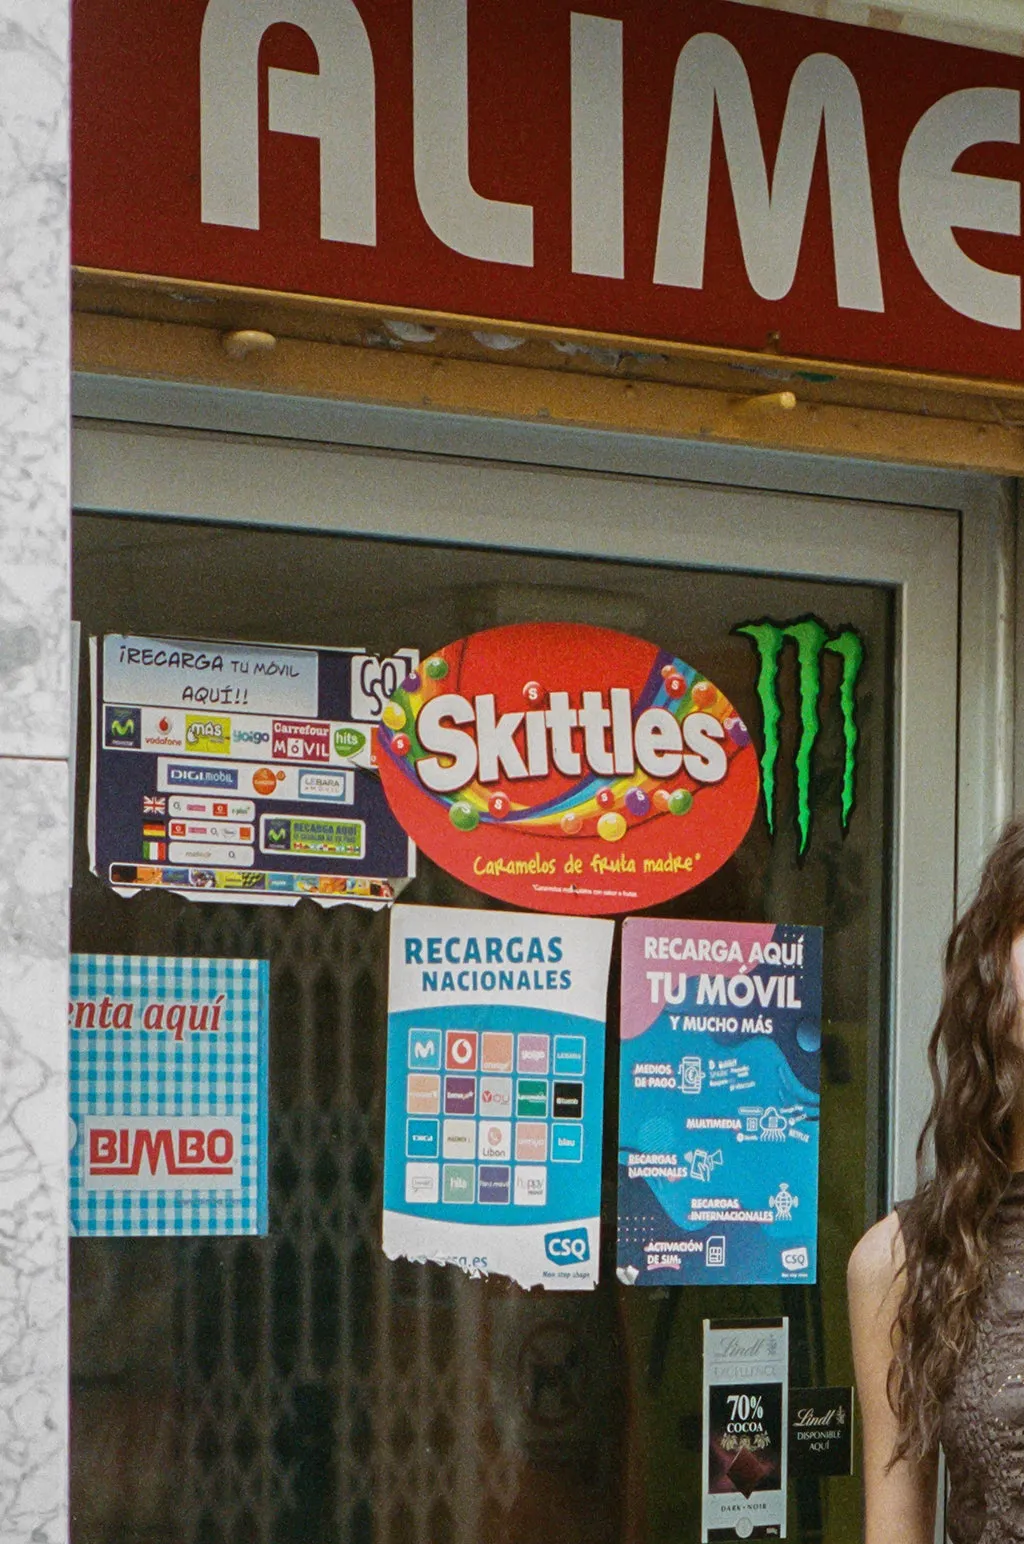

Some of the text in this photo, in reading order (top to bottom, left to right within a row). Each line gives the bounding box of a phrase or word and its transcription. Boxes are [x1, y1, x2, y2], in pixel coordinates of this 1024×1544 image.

[231, 660, 249, 674] TU
[254, 660, 300, 677] MÓVIL
[182, 685, 249, 706] AQUÍ!!
[274, 723, 329, 736] Carrefour
[145, 737, 182, 746] vodafone
[233, 730, 270, 744] yoigo
[336, 733, 358, 744] hits
[416, 688, 728, 792] Skittles
[564, 854, 583, 874] de
[404, 937, 563, 966] RECARGAS
[644, 937, 804, 966] RECARGA AQUÍ
[421, 970, 571, 992] NACIONALES
[646, 965, 802, 1009] TU MÓVIL
[144, 995, 226, 1041] aquí
[670, 1013, 773, 1034] Y MUCHO MÁS
[635, 1064, 672, 1075] MEDIOS
[635, 1077, 676, 1088] DE PAGO
[686, 1118, 742, 1129] MULTIMEDIA
[89, 1129, 234, 1176] BIMBO
[628, 1154, 677, 1165] RECARGAS
[628, 1167, 687, 1178] NACIONALES
[691, 1199, 739, 1209] RECARGAS
[691, 1211, 773, 1221] INTERNACIONALES
[548, 1238, 588, 1260] CSQ
[648, 1240, 703, 1252] ACTIVACIÓN
[647, 1255, 660, 1265] DE
[785, 1254, 805, 1266] CSQ
[726, 1394, 764, 1421] 70%
[792, 1408, 836, 1427] Lindt
[726, 1422, 763, 1433] COCOA
[797, 1430, 841, 1440] DISPONIBLE
[809, 1440, 830, 1451] AQUÍ
